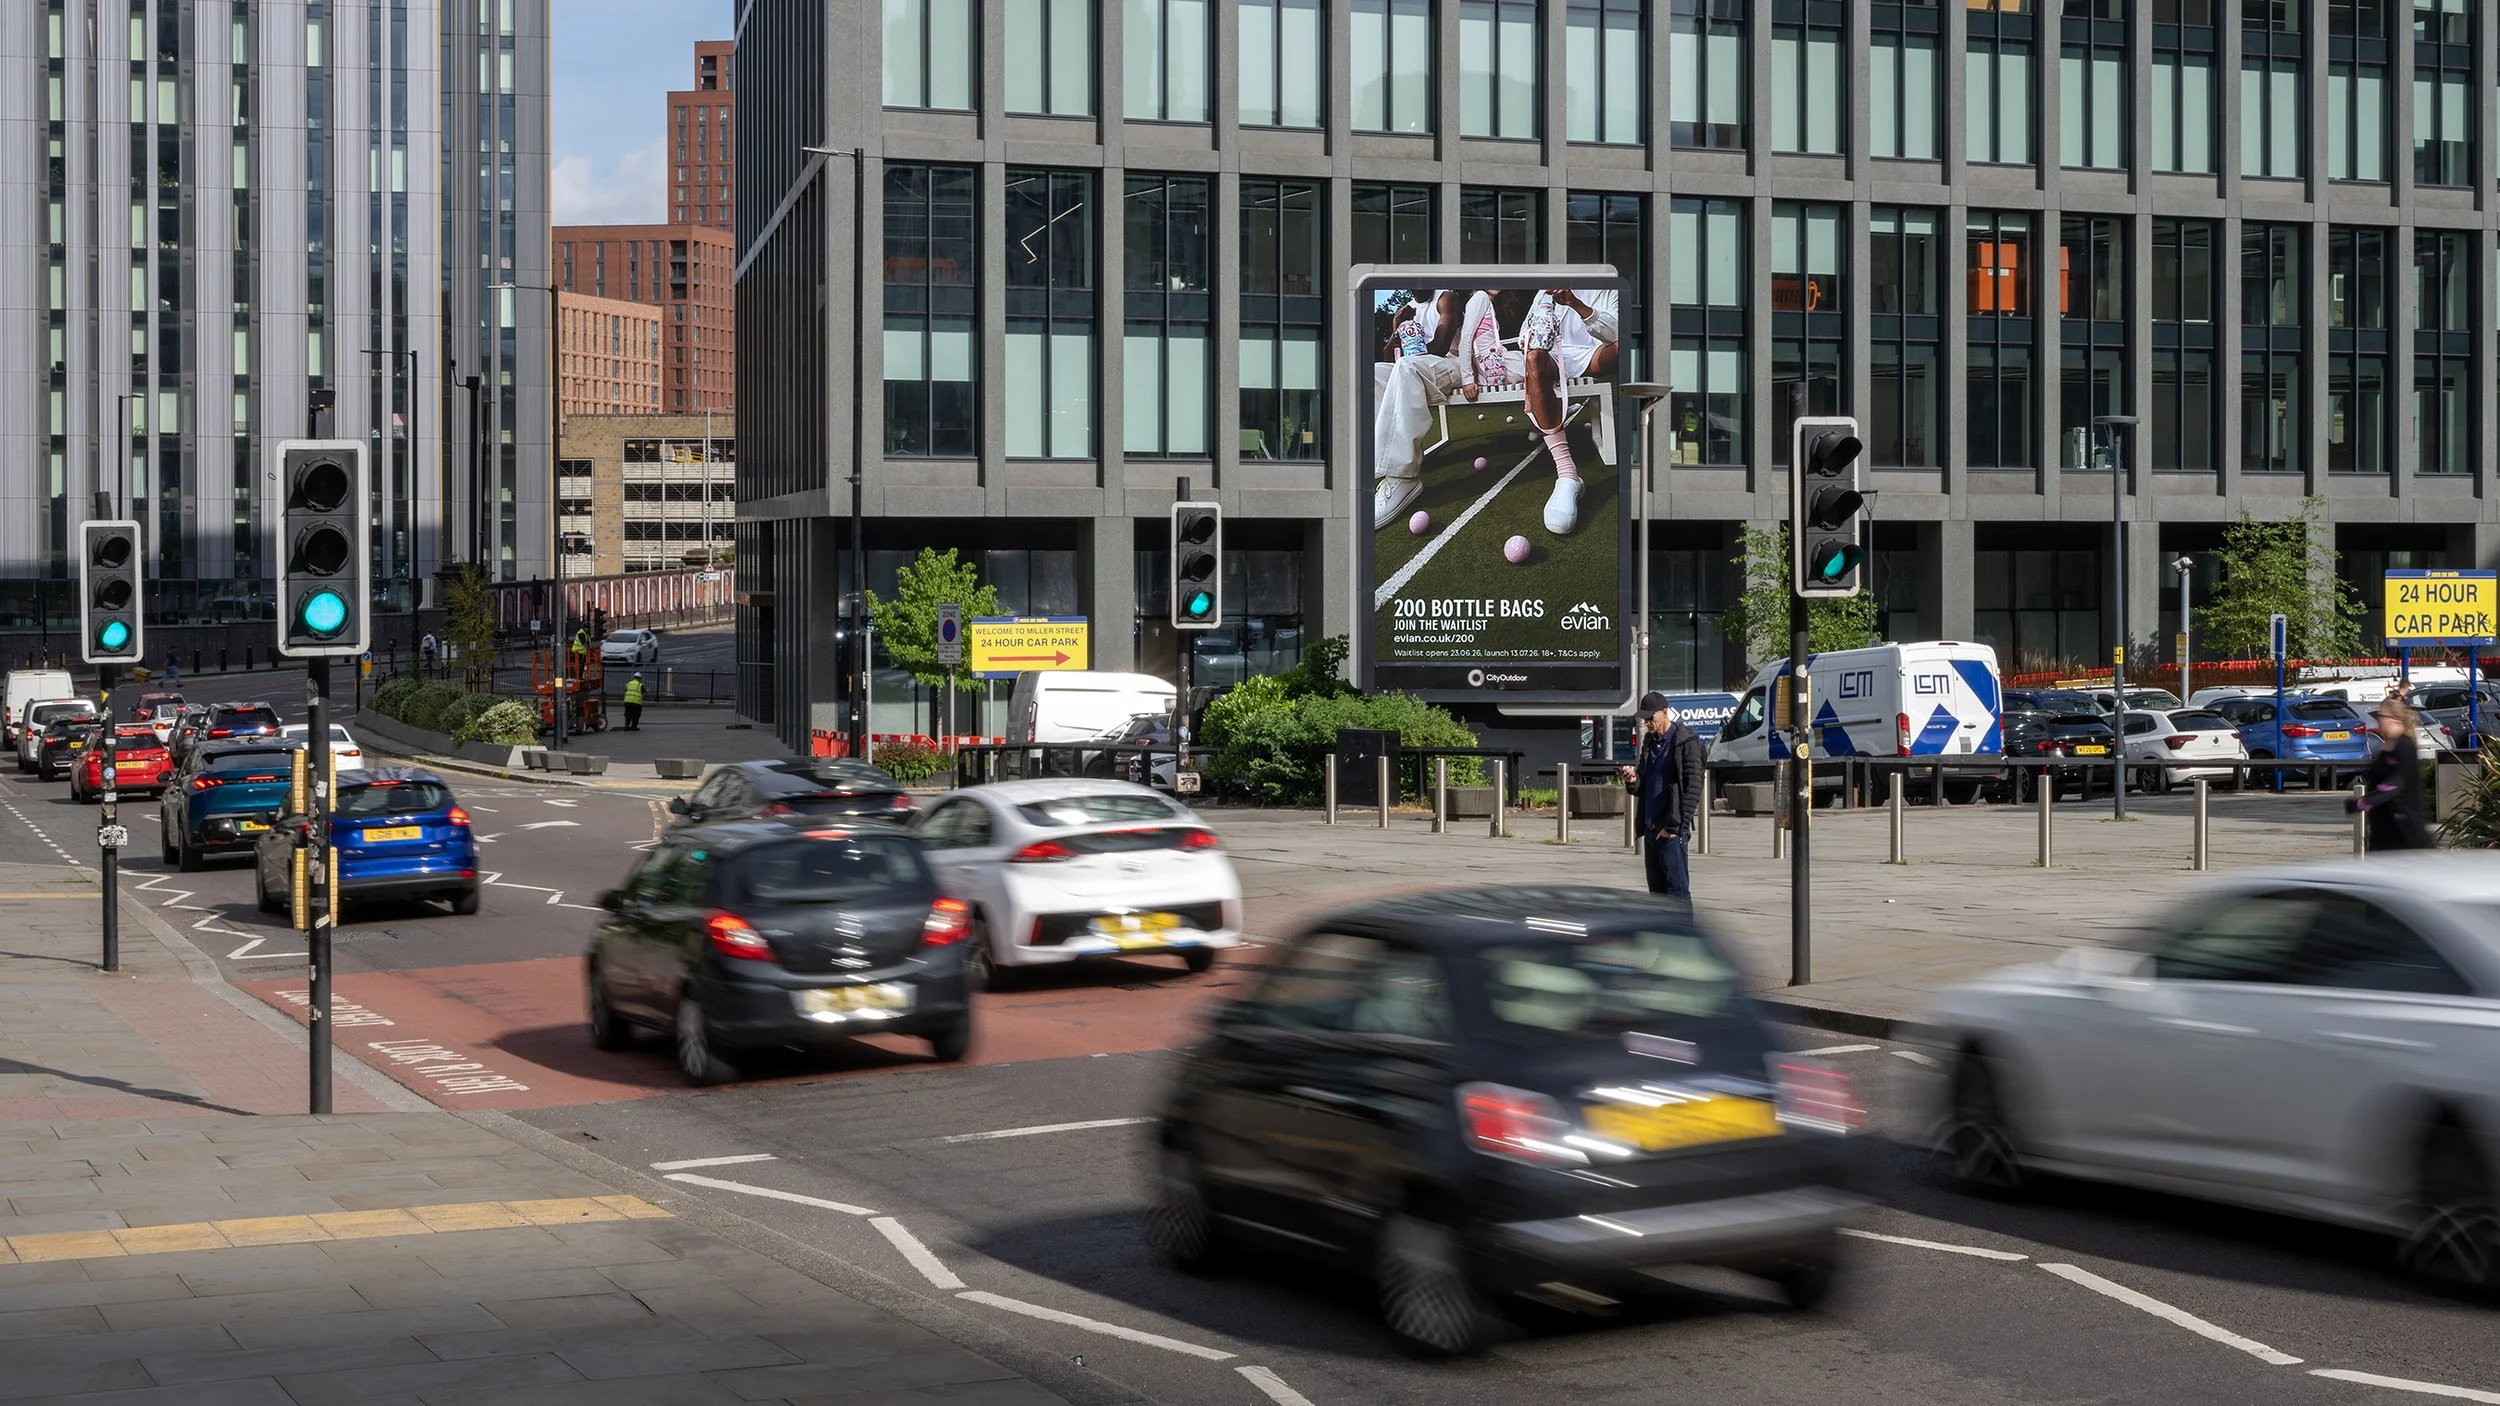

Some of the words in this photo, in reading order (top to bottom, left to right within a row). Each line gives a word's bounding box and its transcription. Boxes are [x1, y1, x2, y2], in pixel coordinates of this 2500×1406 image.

[2400, 584, 2420, 603] 24
[2426, 584, 2478, 603] HOUR
[1394, 599, 1426, 617] 200
[1431, 599, 1495, 617] BOTTLE
[1500, 599, 1545, 618] BAGS
[1394, 620, 1416, 631] JOIN
[1419, 620, 1438, 631] THE
[1441, 620, 1488, 631] WAITLIST
[1560, 612, 1608, 630] evian
[2394, 614, 2433, 634] CAR
[2439, 614, 2489, 633] PARK
[1027, 627, 1054, 635] MILLER
[1056, 627, 1085, 635] STREET
[1394, 633, 1475, 643] evian.co.uk/200
[981, 638, 992, 647] 24
[995, 638, 1024, 647] HOUR
[1027, 638, 1048, 647] CAR
[1051, 637, 1079, 646] PARK
[1394, 649, 1424, 657] Waitlist
[1484, 649, 1509, 657] launch
[1558, 649, 1578, 657] T&Cs
[367, 1038, 468, 1066] LOOK
[413, 1062, 531, 1095] RIGHT
